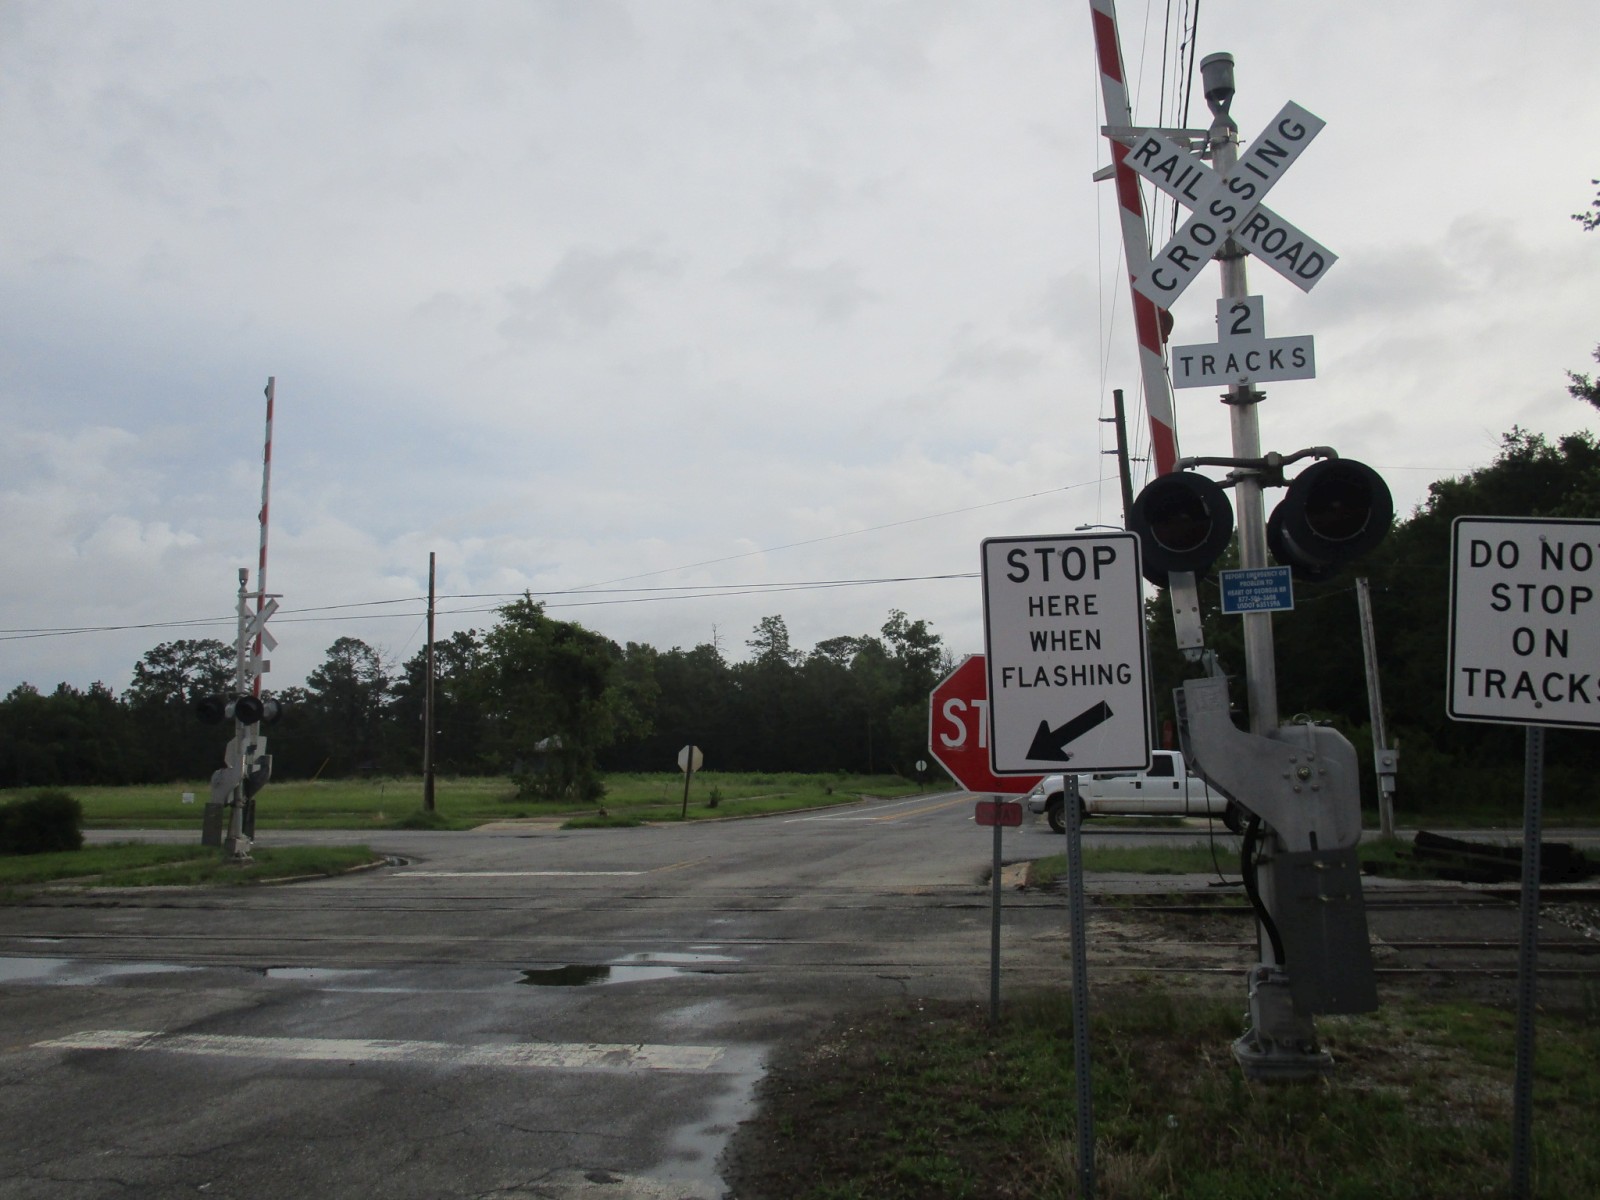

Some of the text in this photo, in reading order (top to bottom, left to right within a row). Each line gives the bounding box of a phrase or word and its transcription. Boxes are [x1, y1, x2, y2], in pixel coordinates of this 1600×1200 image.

[1133, 137, 1325, 279] RAIL ROAD
[1151, 118, 1306, 291] CROSSING
[1230, 304, 1251, 335] 2
[1180, 347, 1306, 377] TRACKS
[1006, 545, 1116, 583] STOP
[1470, 539, 1600, 572] DO NO
[1028, 594, 1098, 617] HERE
[1254, 587, 1278, 595] GEORGIA
[1490, 583, 1593, 615] STOP
[1029, 629, 1101, 652] WHEN
[1512, 627, 1568, 658] ON
[1002, 663, 1131, 688] FLASHING
[1462, 667, 1600, 704] TRACK
[939, 698, 987, 748] ST
